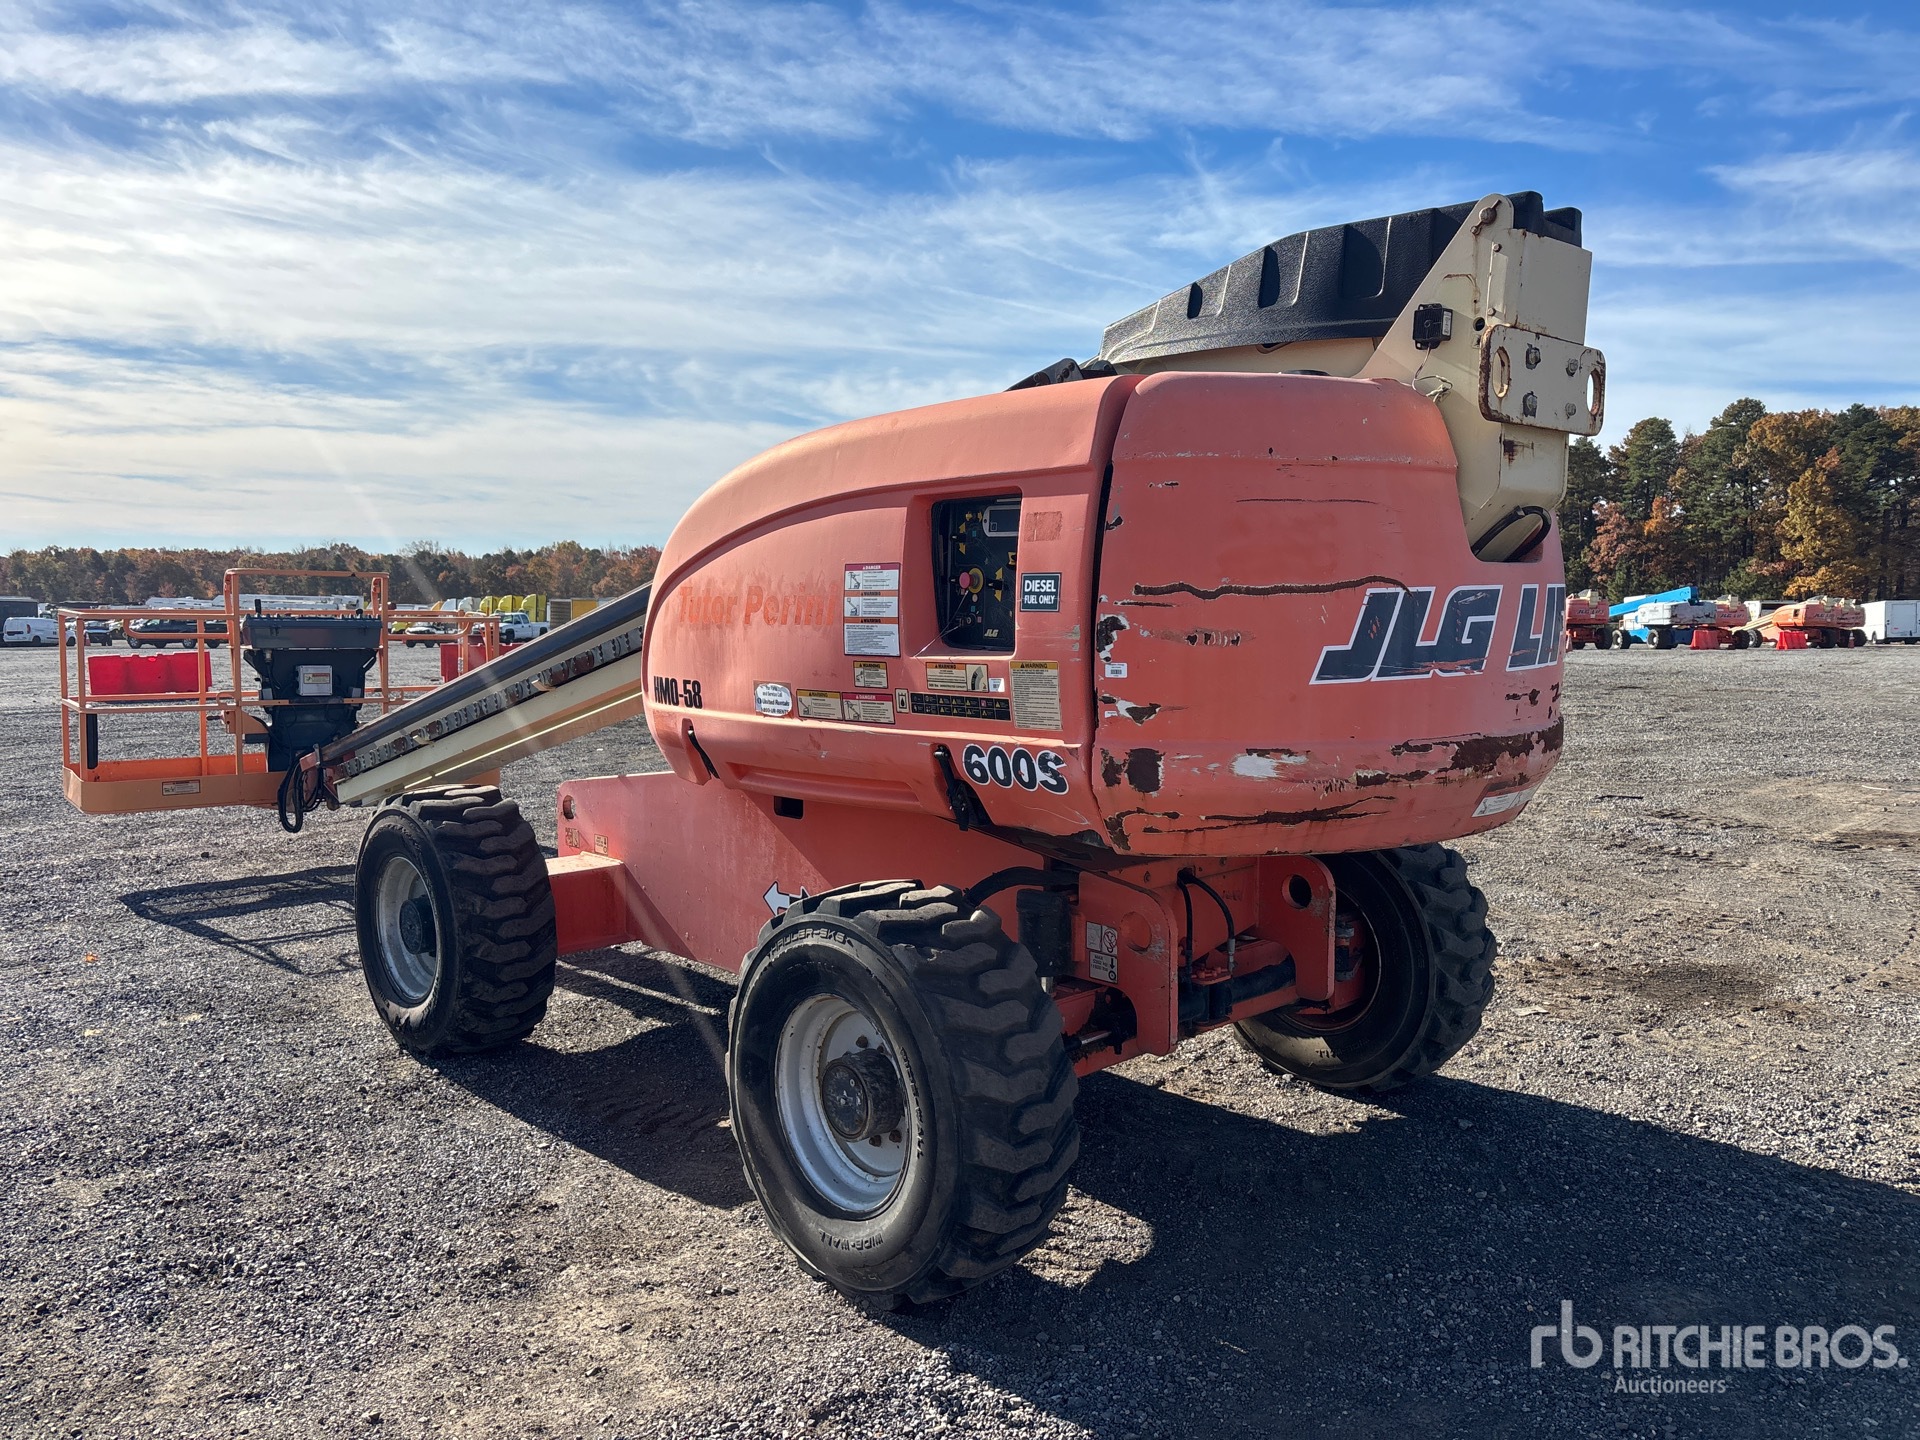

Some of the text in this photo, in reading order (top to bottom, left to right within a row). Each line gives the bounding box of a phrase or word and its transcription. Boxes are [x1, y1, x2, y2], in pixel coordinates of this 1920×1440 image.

[1024, 580, 1057, 592] DIESEL
[1024, 595, 1056, 605] FUEL ONLY
[678, 586, 739, 625] Tutor
[984, 628, 999, 637] JLG
[1309, 585, 1504, 685] JLG
[653, 675, 703, 710] HMO-58
[963, 743, 1069, 795] 600S
